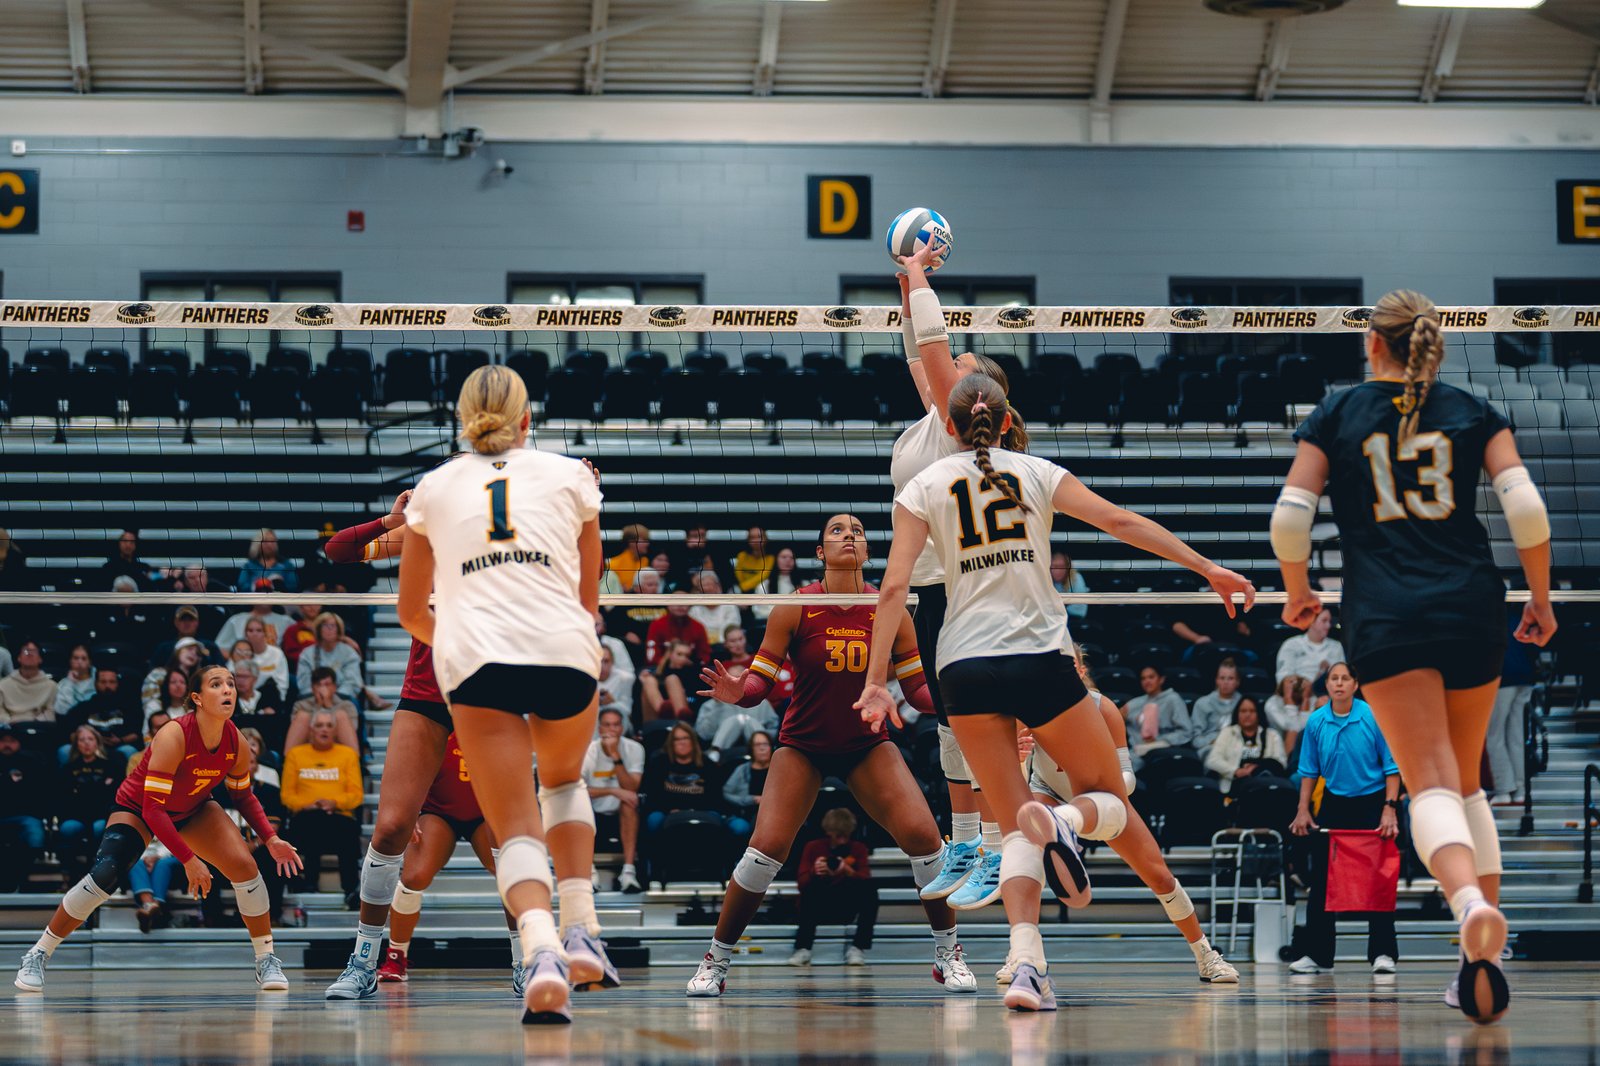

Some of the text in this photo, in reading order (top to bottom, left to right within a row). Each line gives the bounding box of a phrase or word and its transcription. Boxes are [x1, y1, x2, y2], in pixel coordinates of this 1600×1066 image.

[819, 180, 859, 234] D
[1573, 185, 1600, 239] E
[2, 305, 91, 322] PANTHERS
[116, 314, 156, 325] MILWAUKEE
[181, 307, 270, 324] PANTHERS
[294, 315, 334, 326] MILWAUKEE
[359, 309, 447, 325] PANTHERS
[472, 316, 511, 327] MILWAUKEE
[536, 309, 623, 326] PANTHERS
[712, 310, 798, 326] PANTHERS
[1060, 311, 1145, 327] PANTHERS
[1232, 311, 1318, 328] PANTHERS
[1437, 311, 1488, 327] THERS
[648, 317, 687, 328] MILWAUKEE
[823, 318, 862, 328] MILWAUKEE
[997, 318, 1035, 329] MILWAUKEE
[1170, 318, 1208, 329] MILWAUKEE
[1341, 319, 1370, 329] MILWAU
[1512, 318, 1550, 328] MILWAUKEE
[1362, 431, 1456, 522] 13
[484, 477, 518, 543] 1
[948, 470, 1028, 550] 12
[960, 549, 1034, 574] MILWAUKEE
[825, 627, 866, 637] Cyclones
[825, 639, 868, 673] 30
[188, 778, 212, 796] 7
